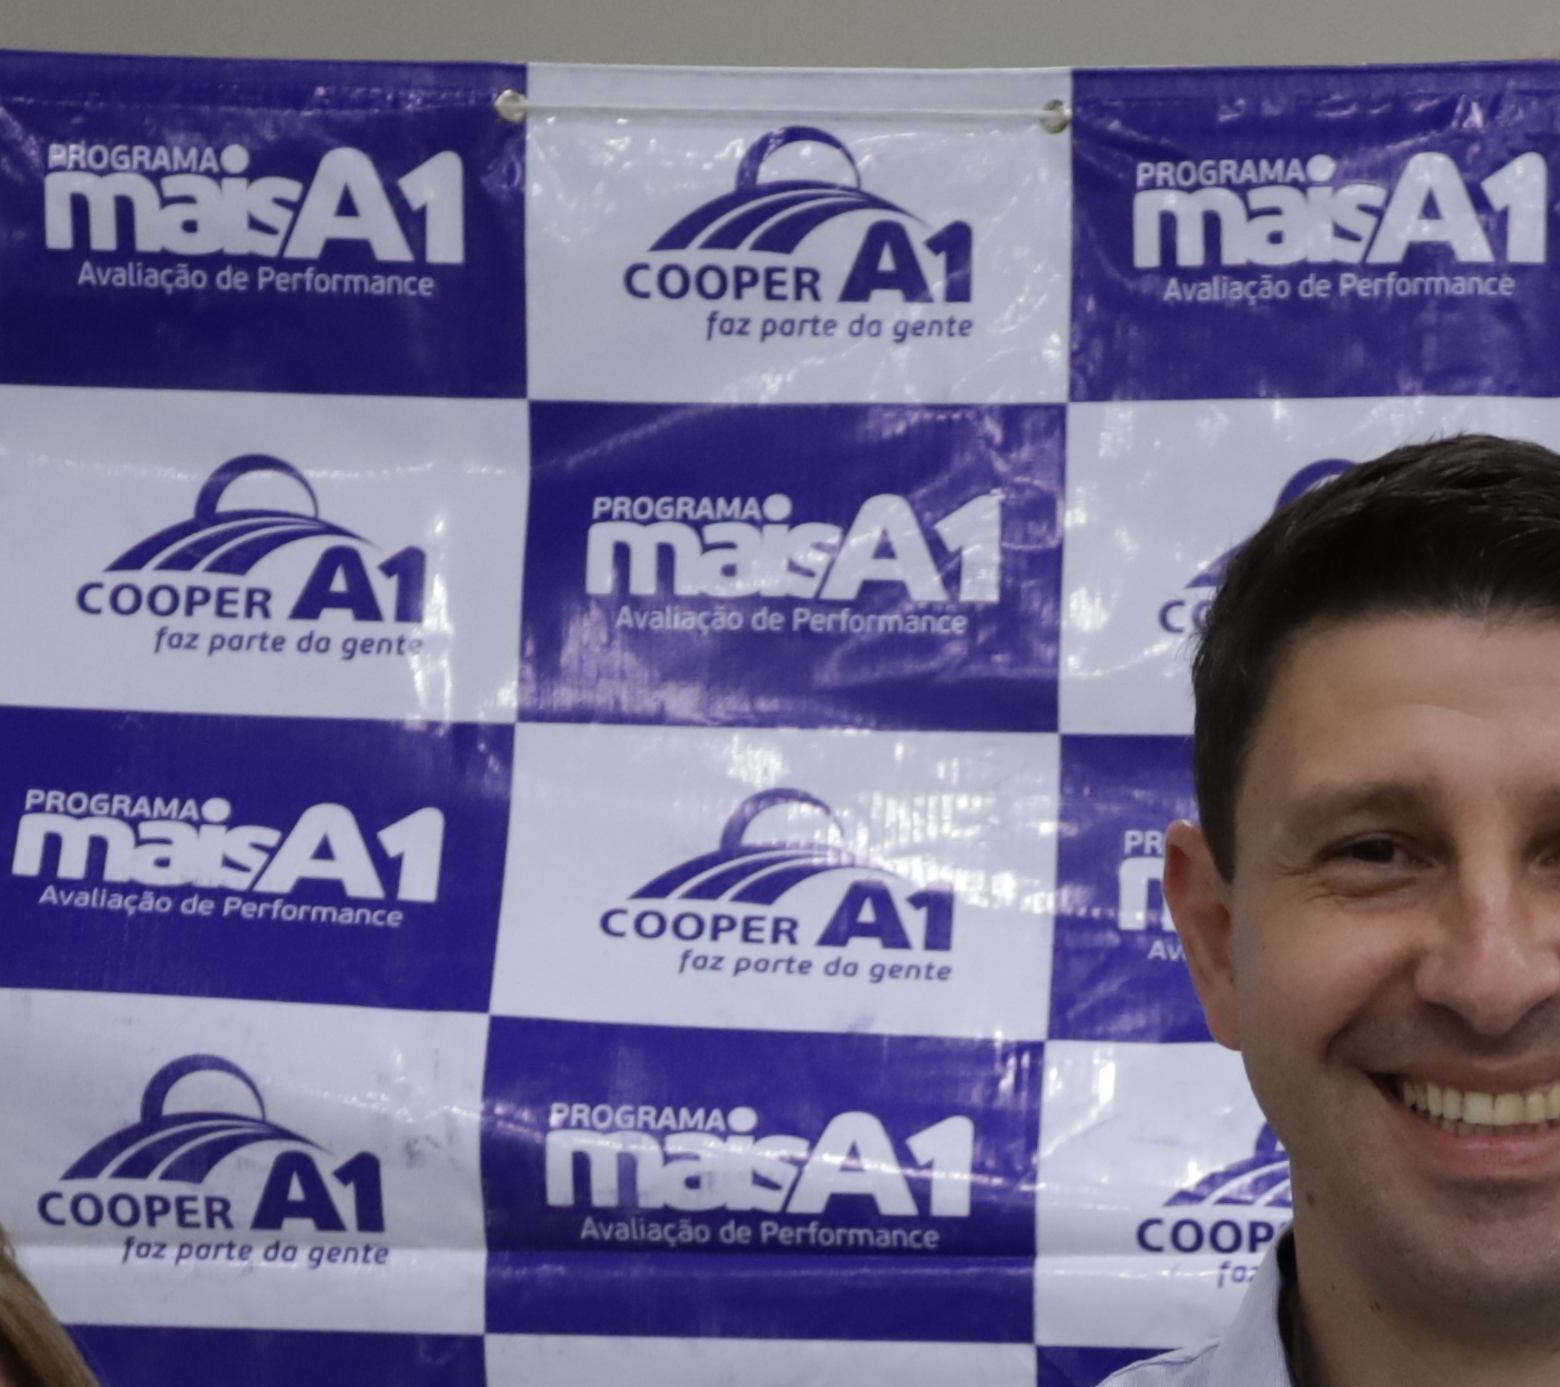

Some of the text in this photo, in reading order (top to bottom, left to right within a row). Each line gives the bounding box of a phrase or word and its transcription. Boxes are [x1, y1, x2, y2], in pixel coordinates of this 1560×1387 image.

[549, 1103, 726, 1131] PROGRAMA
[580, 1216, 940, 1249] Avaliação de Performance
